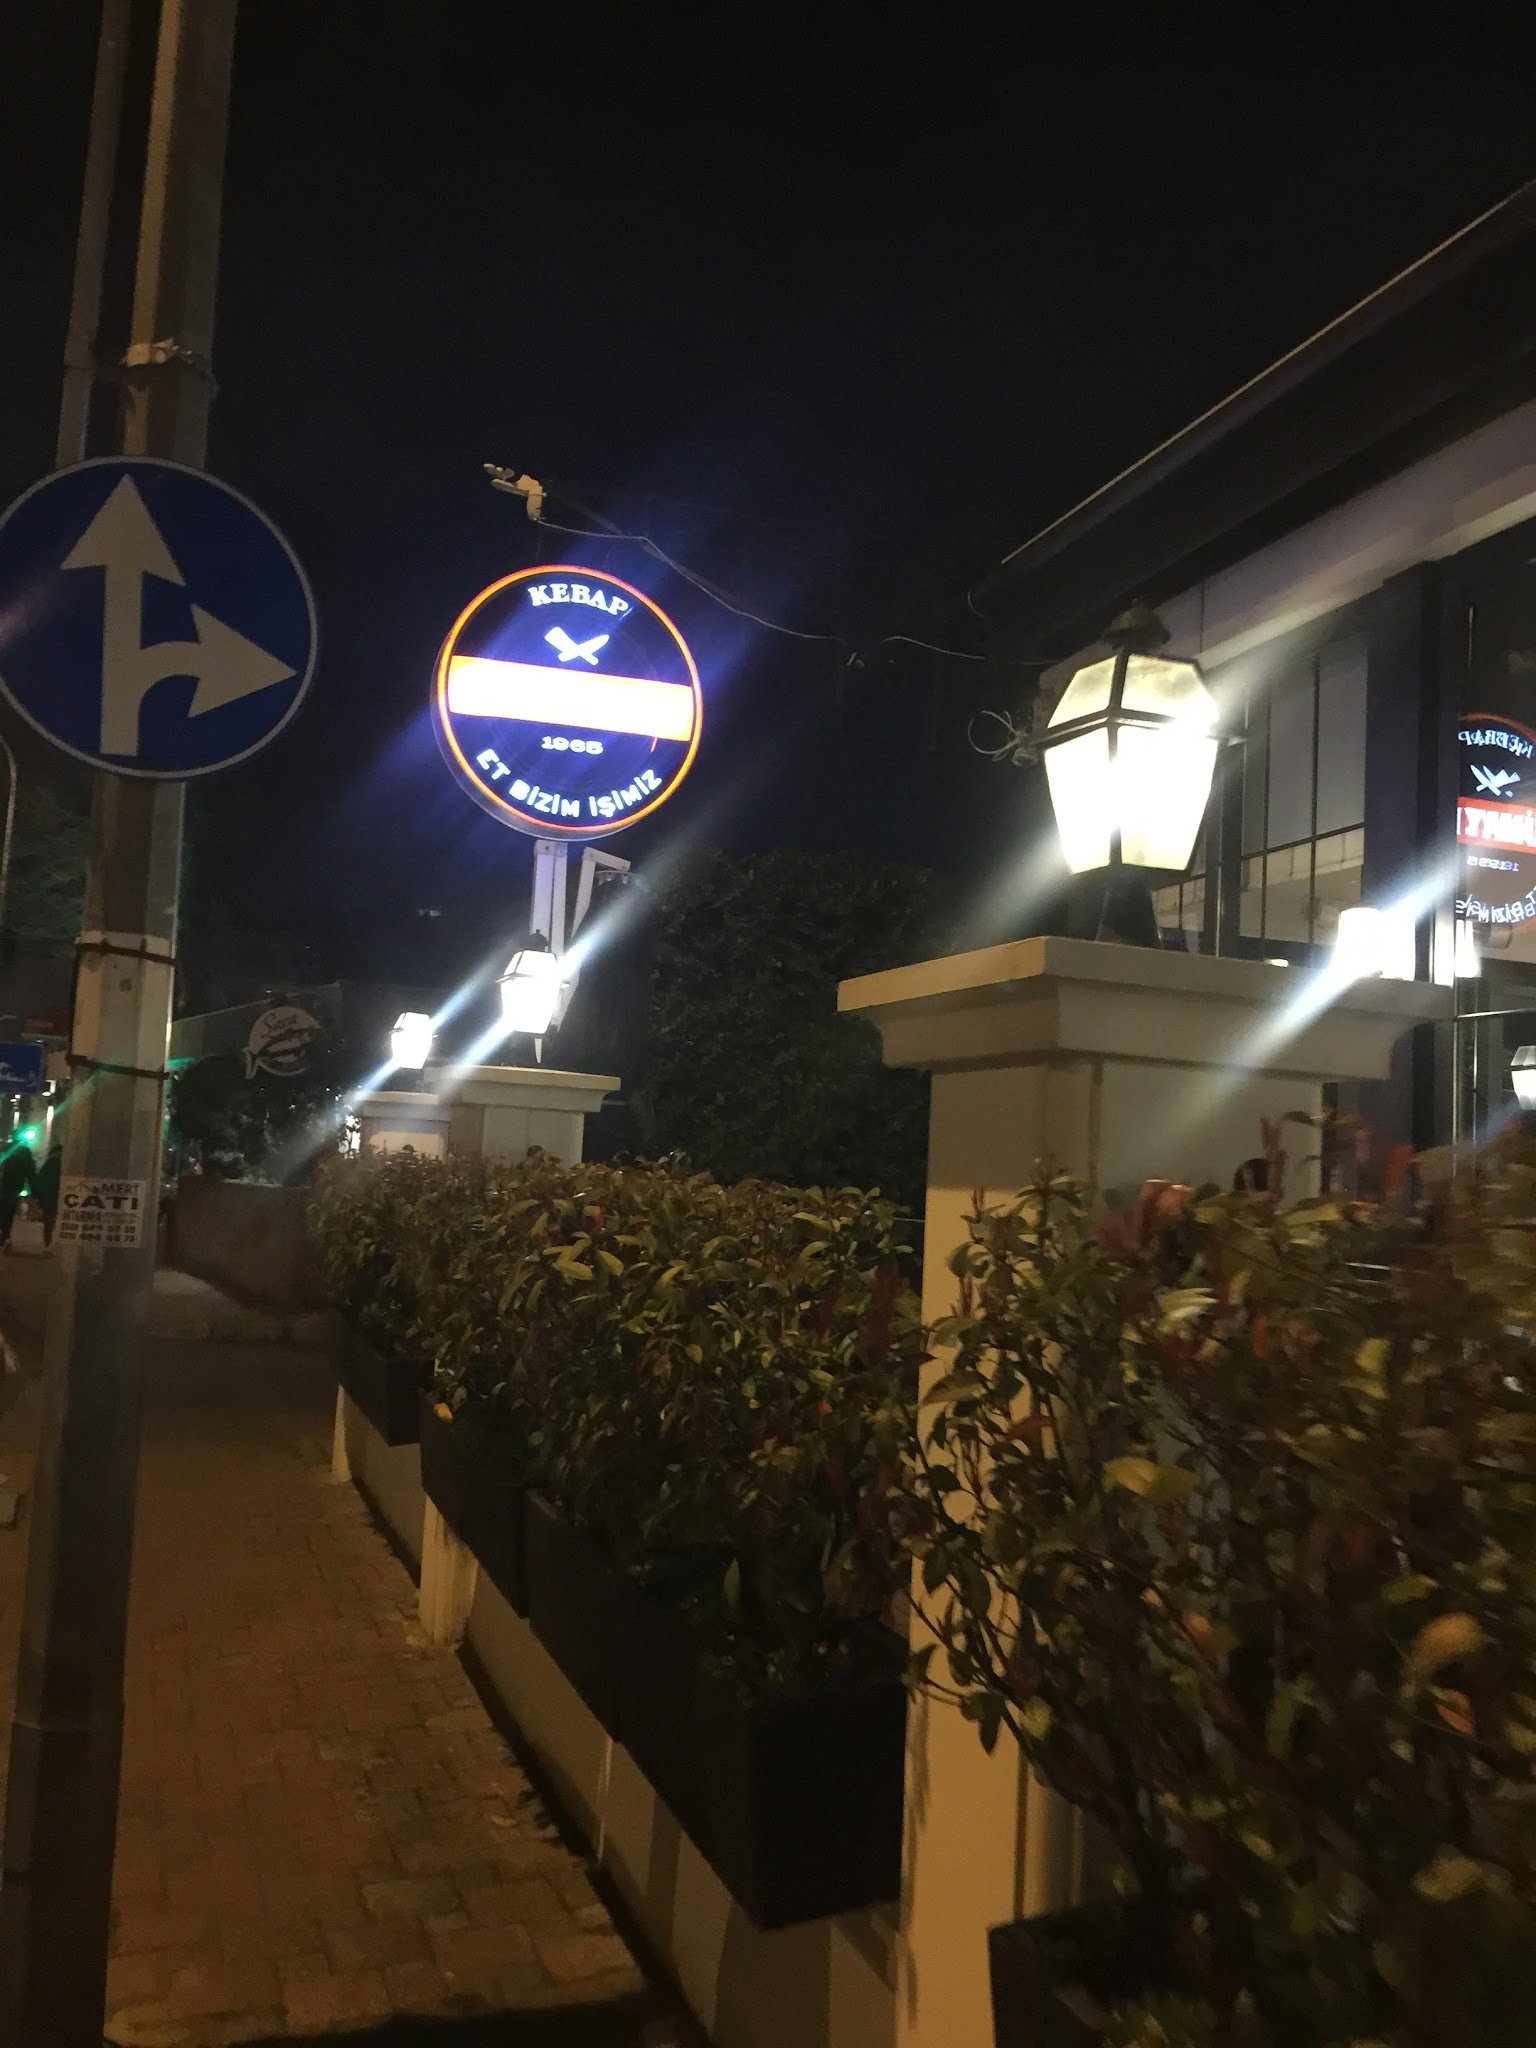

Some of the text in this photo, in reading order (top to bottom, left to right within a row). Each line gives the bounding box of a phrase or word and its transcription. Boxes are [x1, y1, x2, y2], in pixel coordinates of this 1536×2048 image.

[527, 583, 629, 616] KEBAP
[476, 748, 662, 818] ET BİZİM İŞİMİZ
